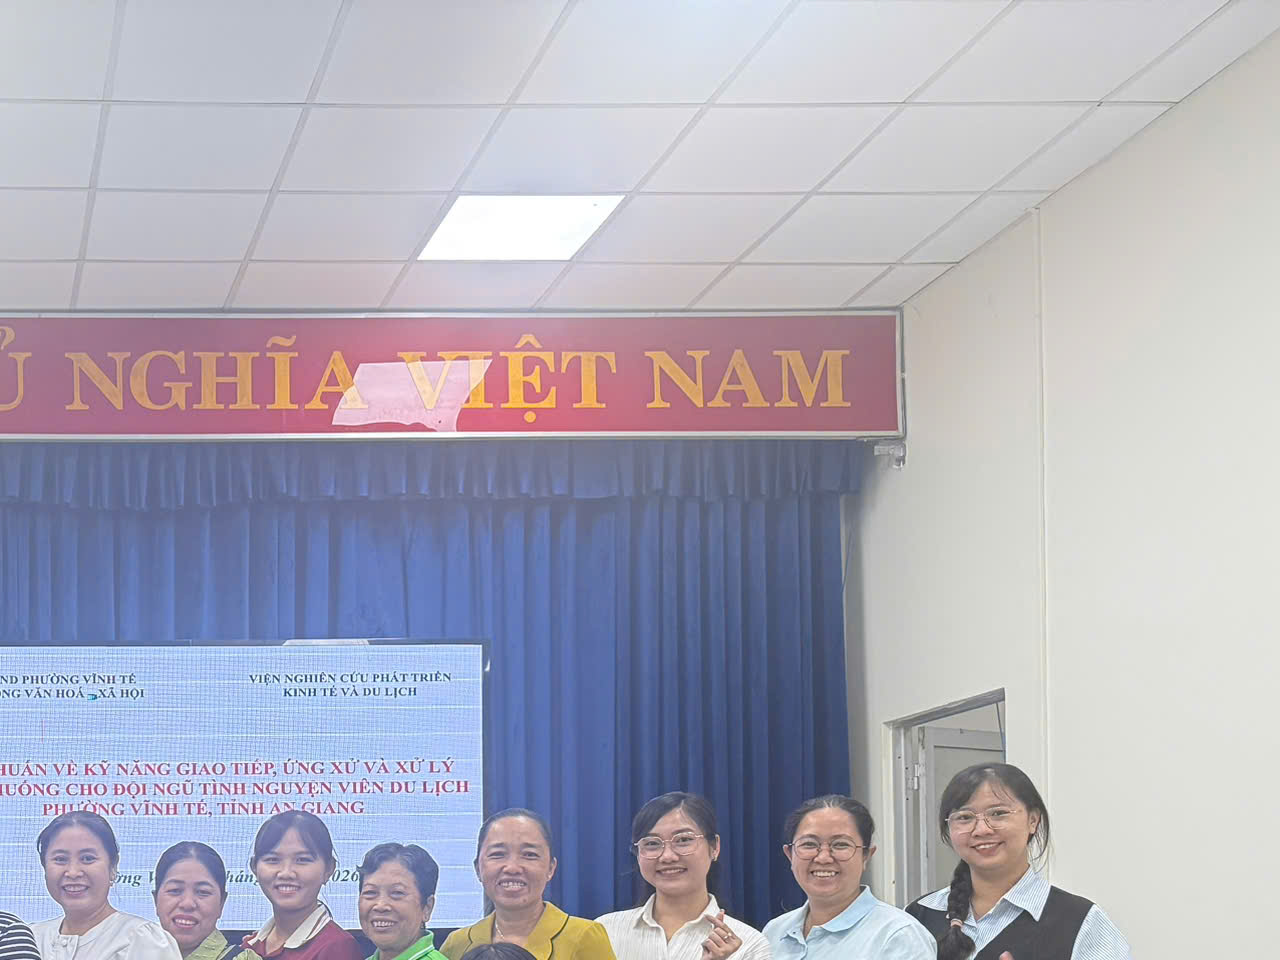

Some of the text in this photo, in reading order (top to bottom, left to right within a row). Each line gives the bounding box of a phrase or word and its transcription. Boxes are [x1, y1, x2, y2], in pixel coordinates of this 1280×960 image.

[64, 335, 368, 411] NGHĨA
[396, 334, 617, 424] VIỆT
[644, 348, 851, 408] NAM
[22, 672, 79, 685] PHƯỜNG
[83, 672, 116, 685] VĨNH
[249, 672, 281, 687] VIỆN
[284, 671, 336, 684] NGHIÊN
[340, 671, 369, 684] CỨU
[373, 671, 408, 683] PHÁT
[24, 687, 52, 699] VĂN
[56, 686, 85, 699] HOÁ
[98, 686, 116, 699] XÃ
[120, 687, 144, 701] HỘI
[283, 686, 317, 698] KINH
[341, 685, 359, 697] VÀ
[363, 686, 381, 697] DU
[385, 686, 417, 699] LỊCH
[84, 760, 112, 776] KỸ
[116, 760, 170, 776] NĂNG
[176, 761, 226, 776] GIAO
[283, 758, 324, 775] ỨNG
[329, 757, 360, 775] XỬ
[366, 757, 390, 774] VÀ
[395, 757, 425, 774] XỬ
[429, 756, 455, 774] LÝ
[65, 783, 108, 797] CHO
[113, 781, 147, 799] ĐỘI
[153, 780, 194, 796] NGŨ
[198, 779, 246, 796] TÌNH
[252, 779, 333, 798] NGUYỆN
[337, 778, 384, 795] VIÊN
[390, 780, 416, 794] DU
[422, 780, 470, 797] LỊCH
[130, 800, 179, 816] VĨNH
[301, 800, 365, 815] GIANG
[331, 869, 359, 882] 026
